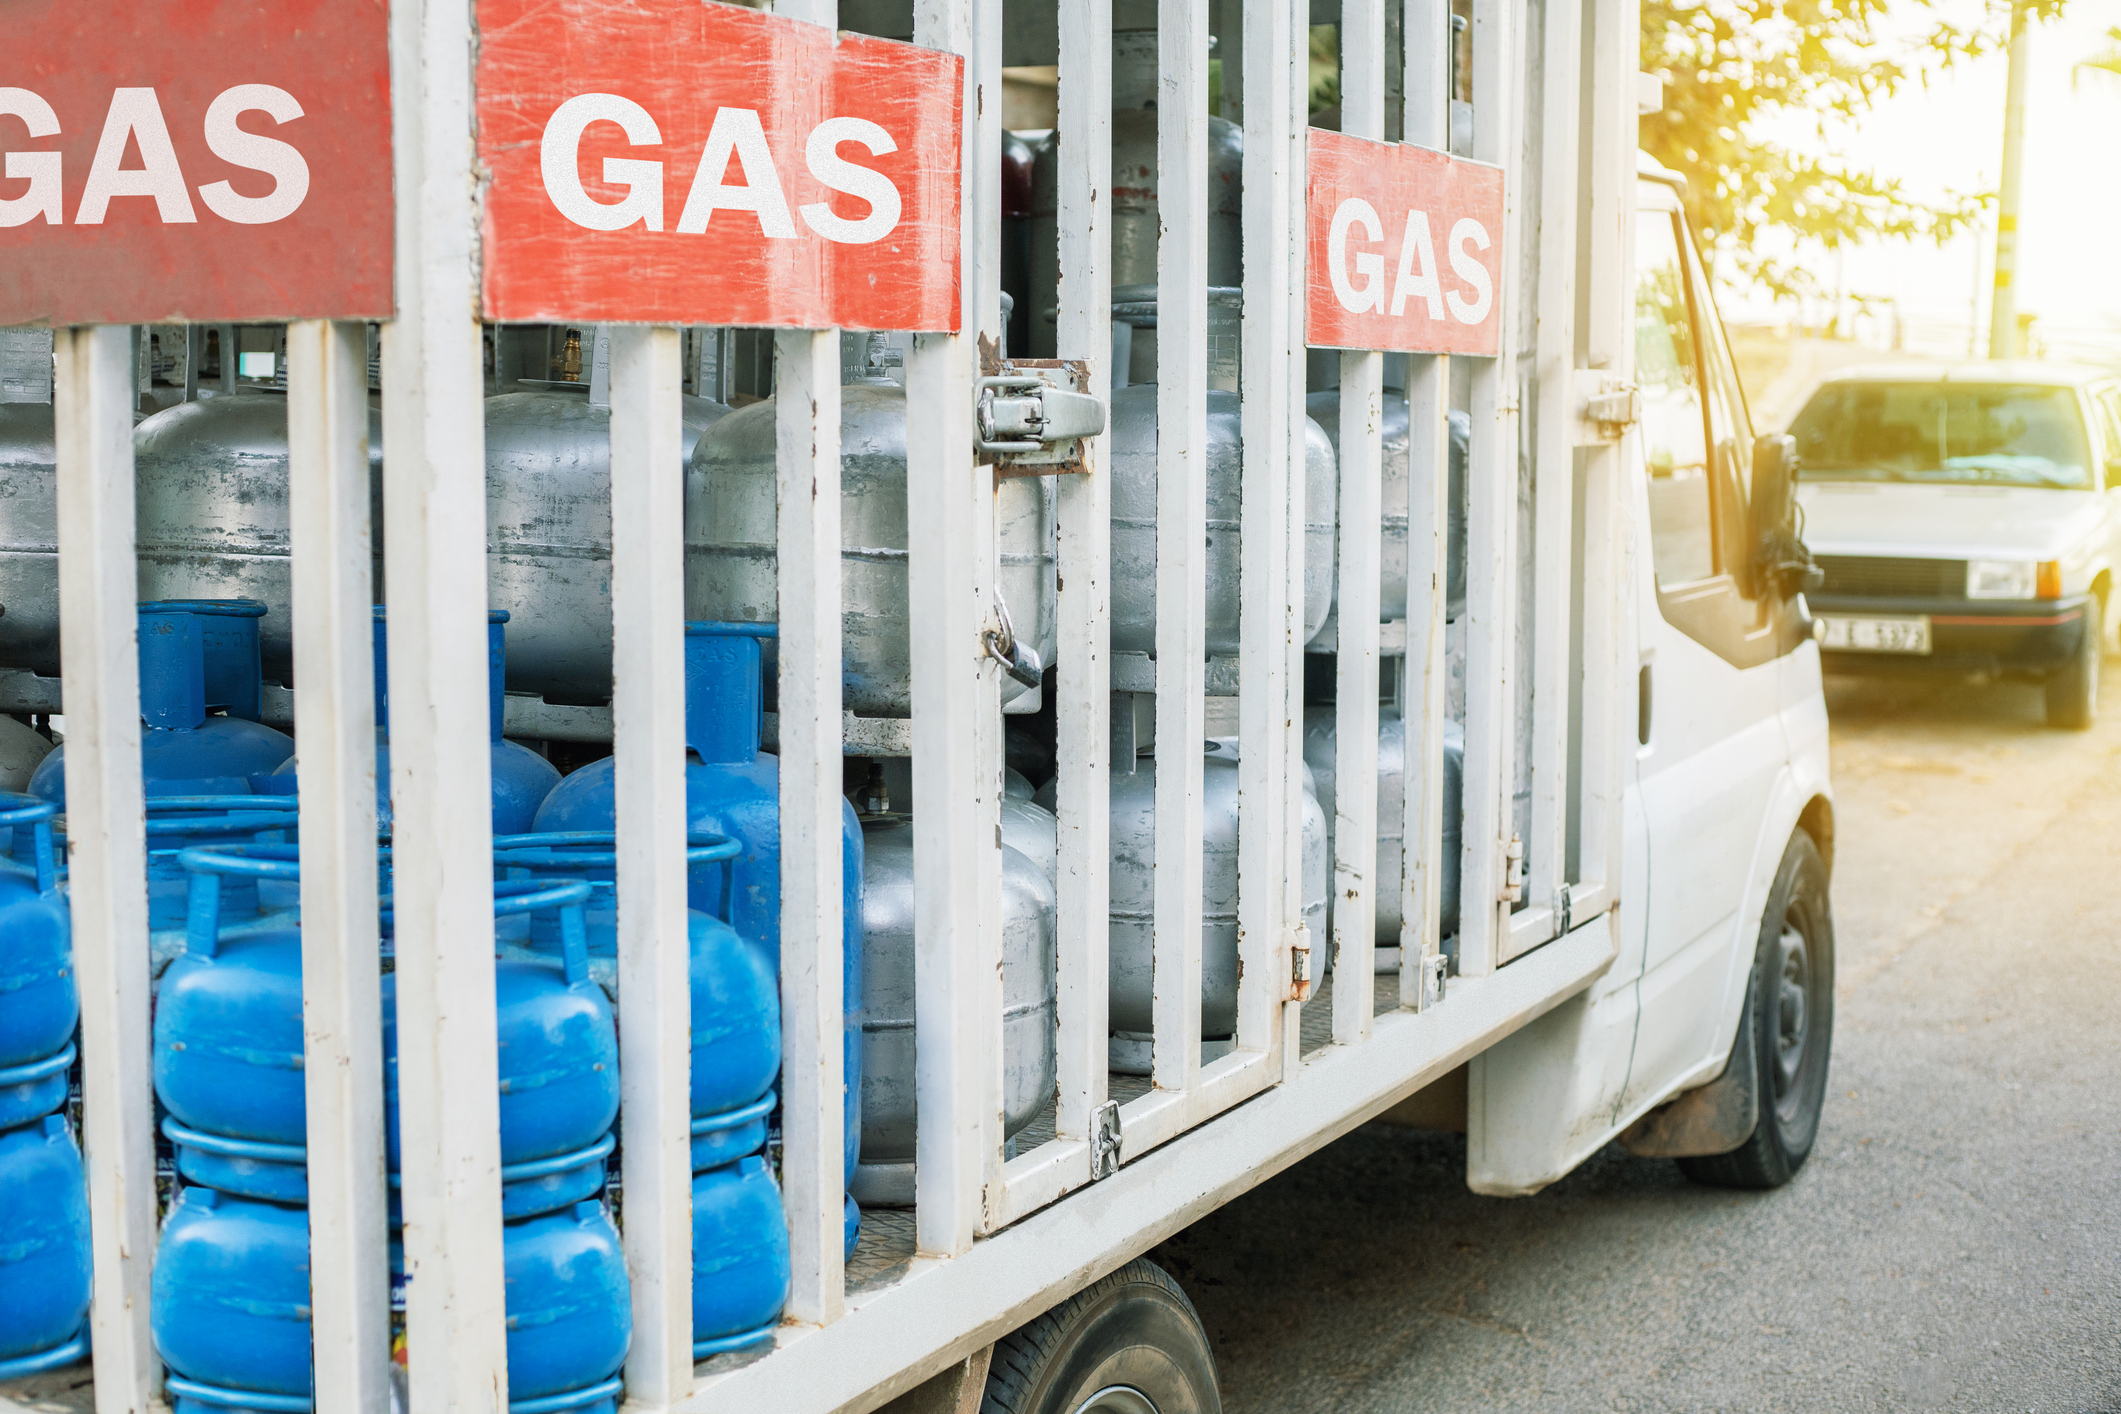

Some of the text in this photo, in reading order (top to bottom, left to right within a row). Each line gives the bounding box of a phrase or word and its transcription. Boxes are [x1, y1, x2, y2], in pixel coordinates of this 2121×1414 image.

[0, 83, 310, 228] GAS
[541, 93, 902, 244] GAS
[1328, 197, 1493, 325] GAS
